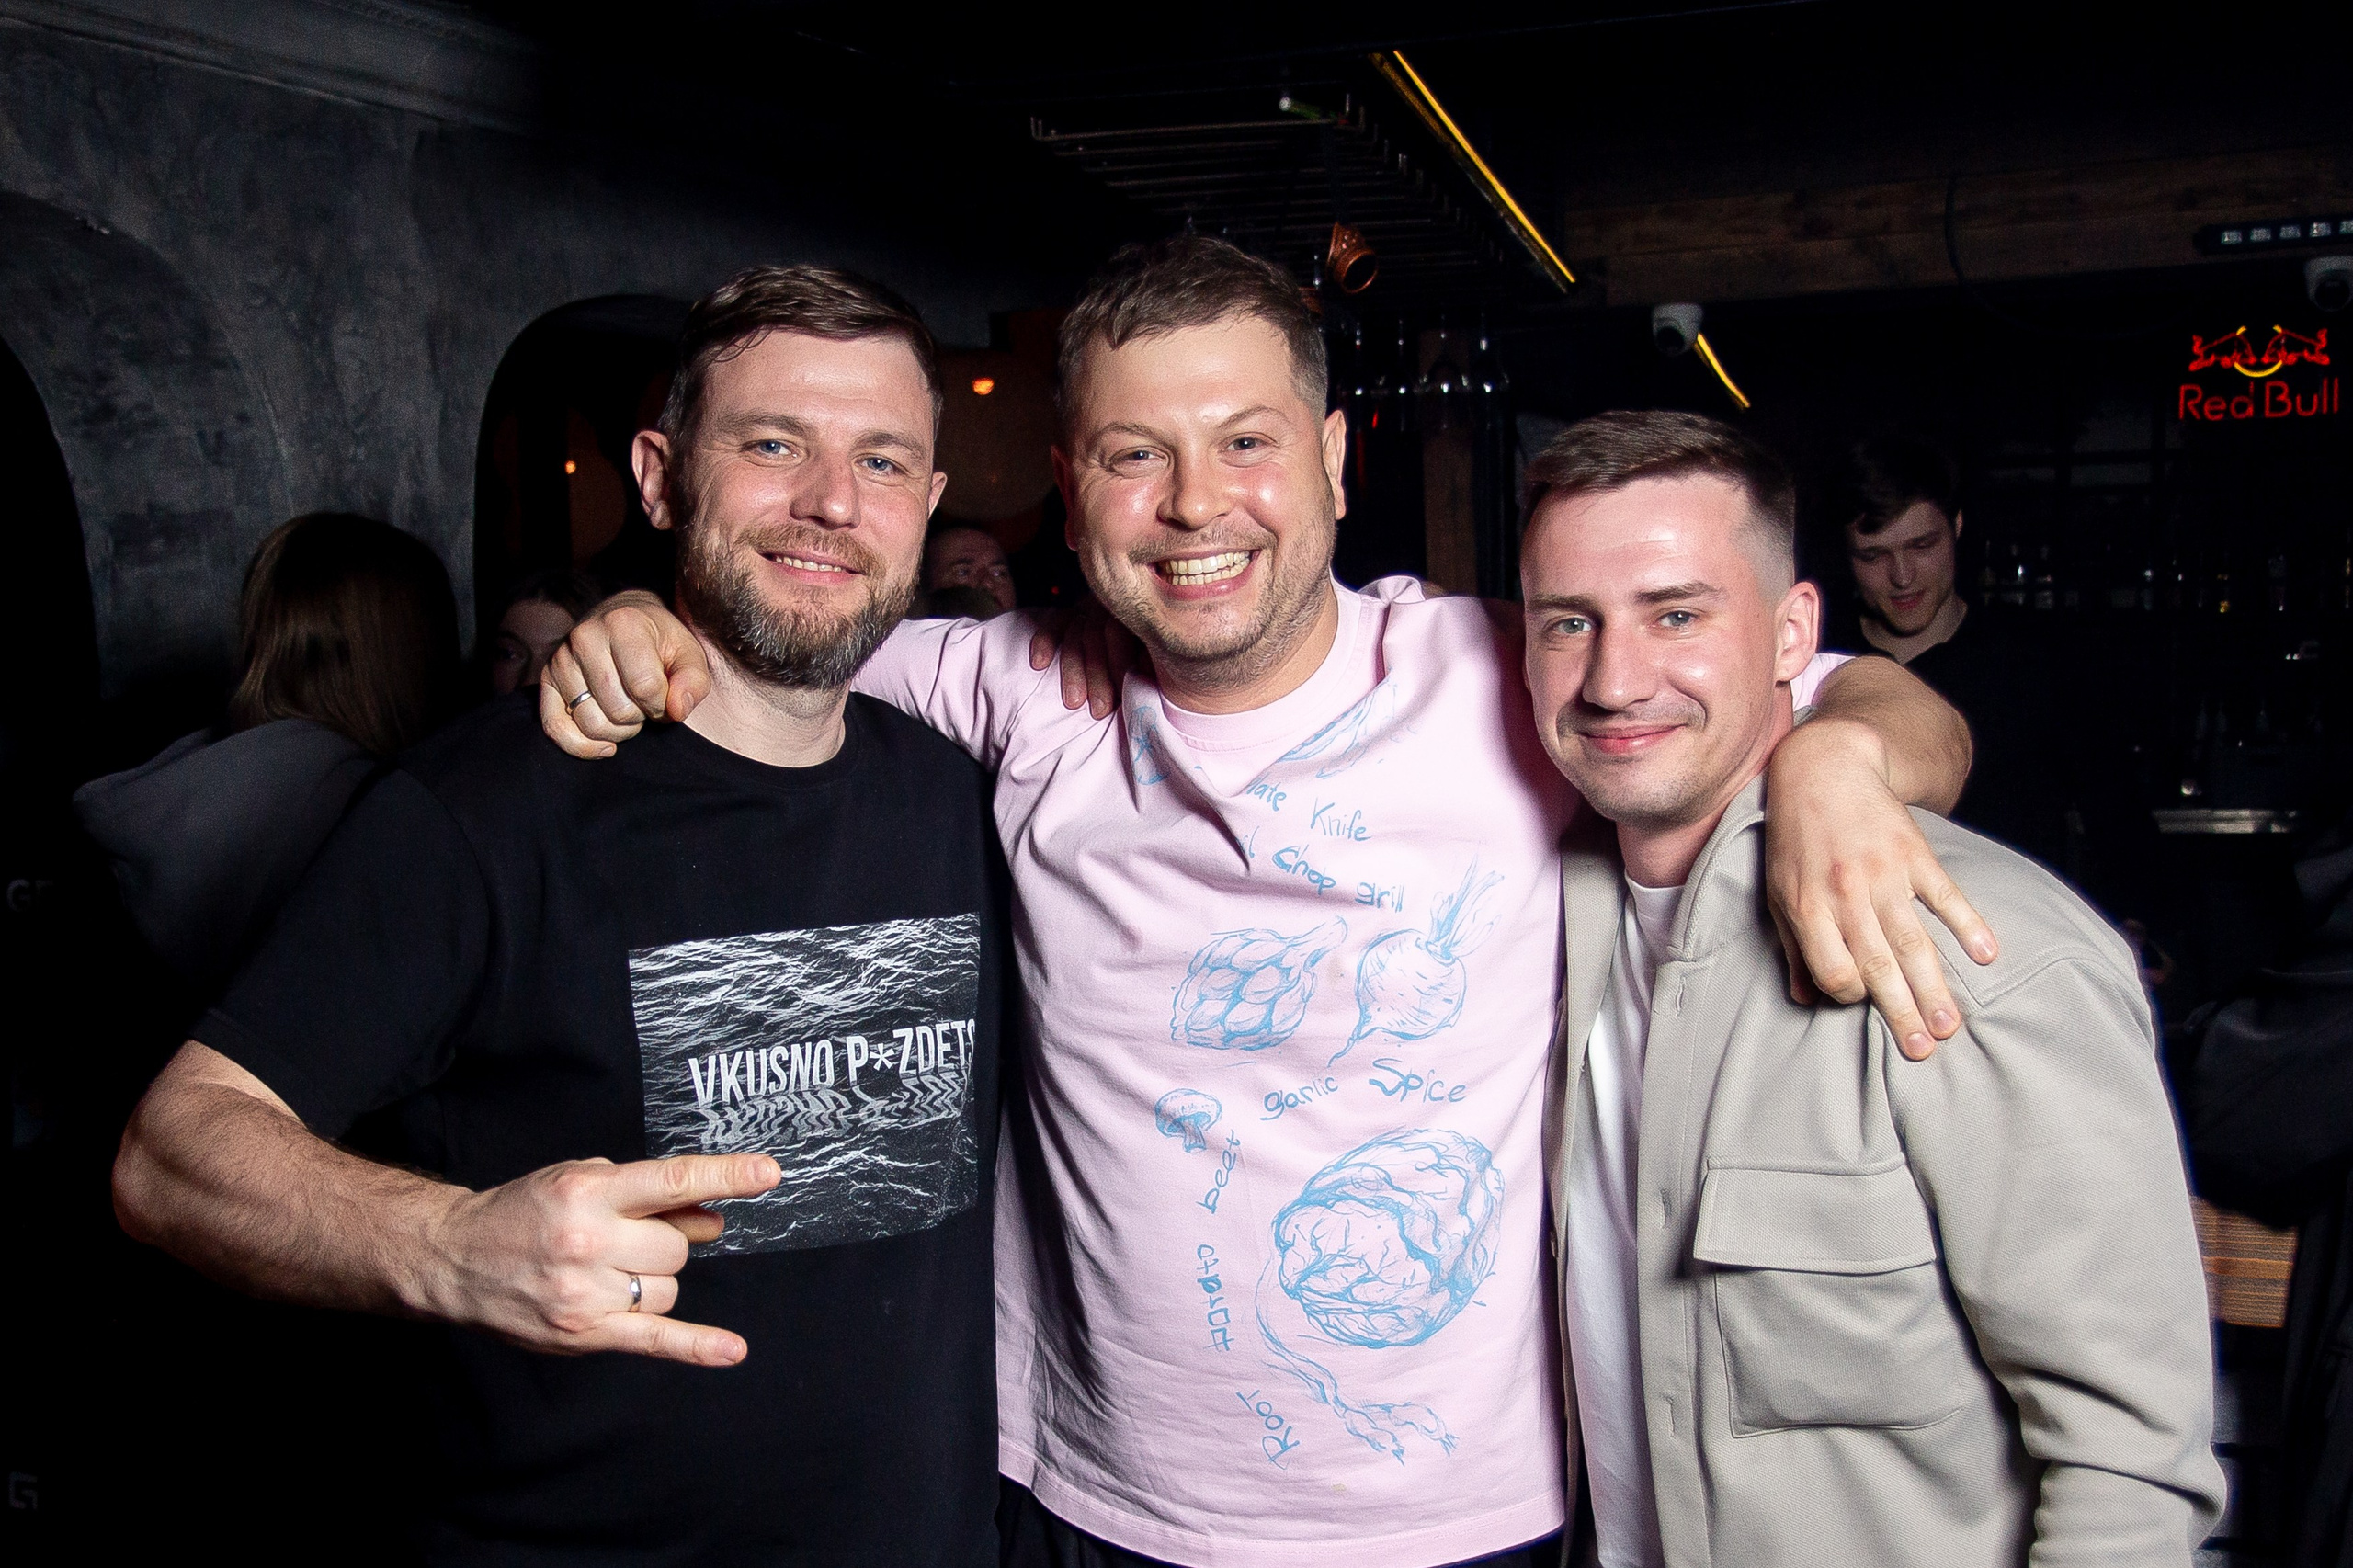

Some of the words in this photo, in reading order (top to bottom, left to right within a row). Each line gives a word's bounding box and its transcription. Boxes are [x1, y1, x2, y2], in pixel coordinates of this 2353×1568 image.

[2178, 380, 2255, 421] Red
[2264, 377, 2339, 418] Bull
[1310, 798, 1371, 841] Knife
[1272, 844, 1336, 896] Chop
[1355, 881, 1404, 914] grill
[688, 1039, 835, 1108] VKUSNO
[1260, 1076, 1339, 1121] garlic
[1369, 1058, 1468, 1104] Spice
[1195, 1129, 1241, 1214] beet
